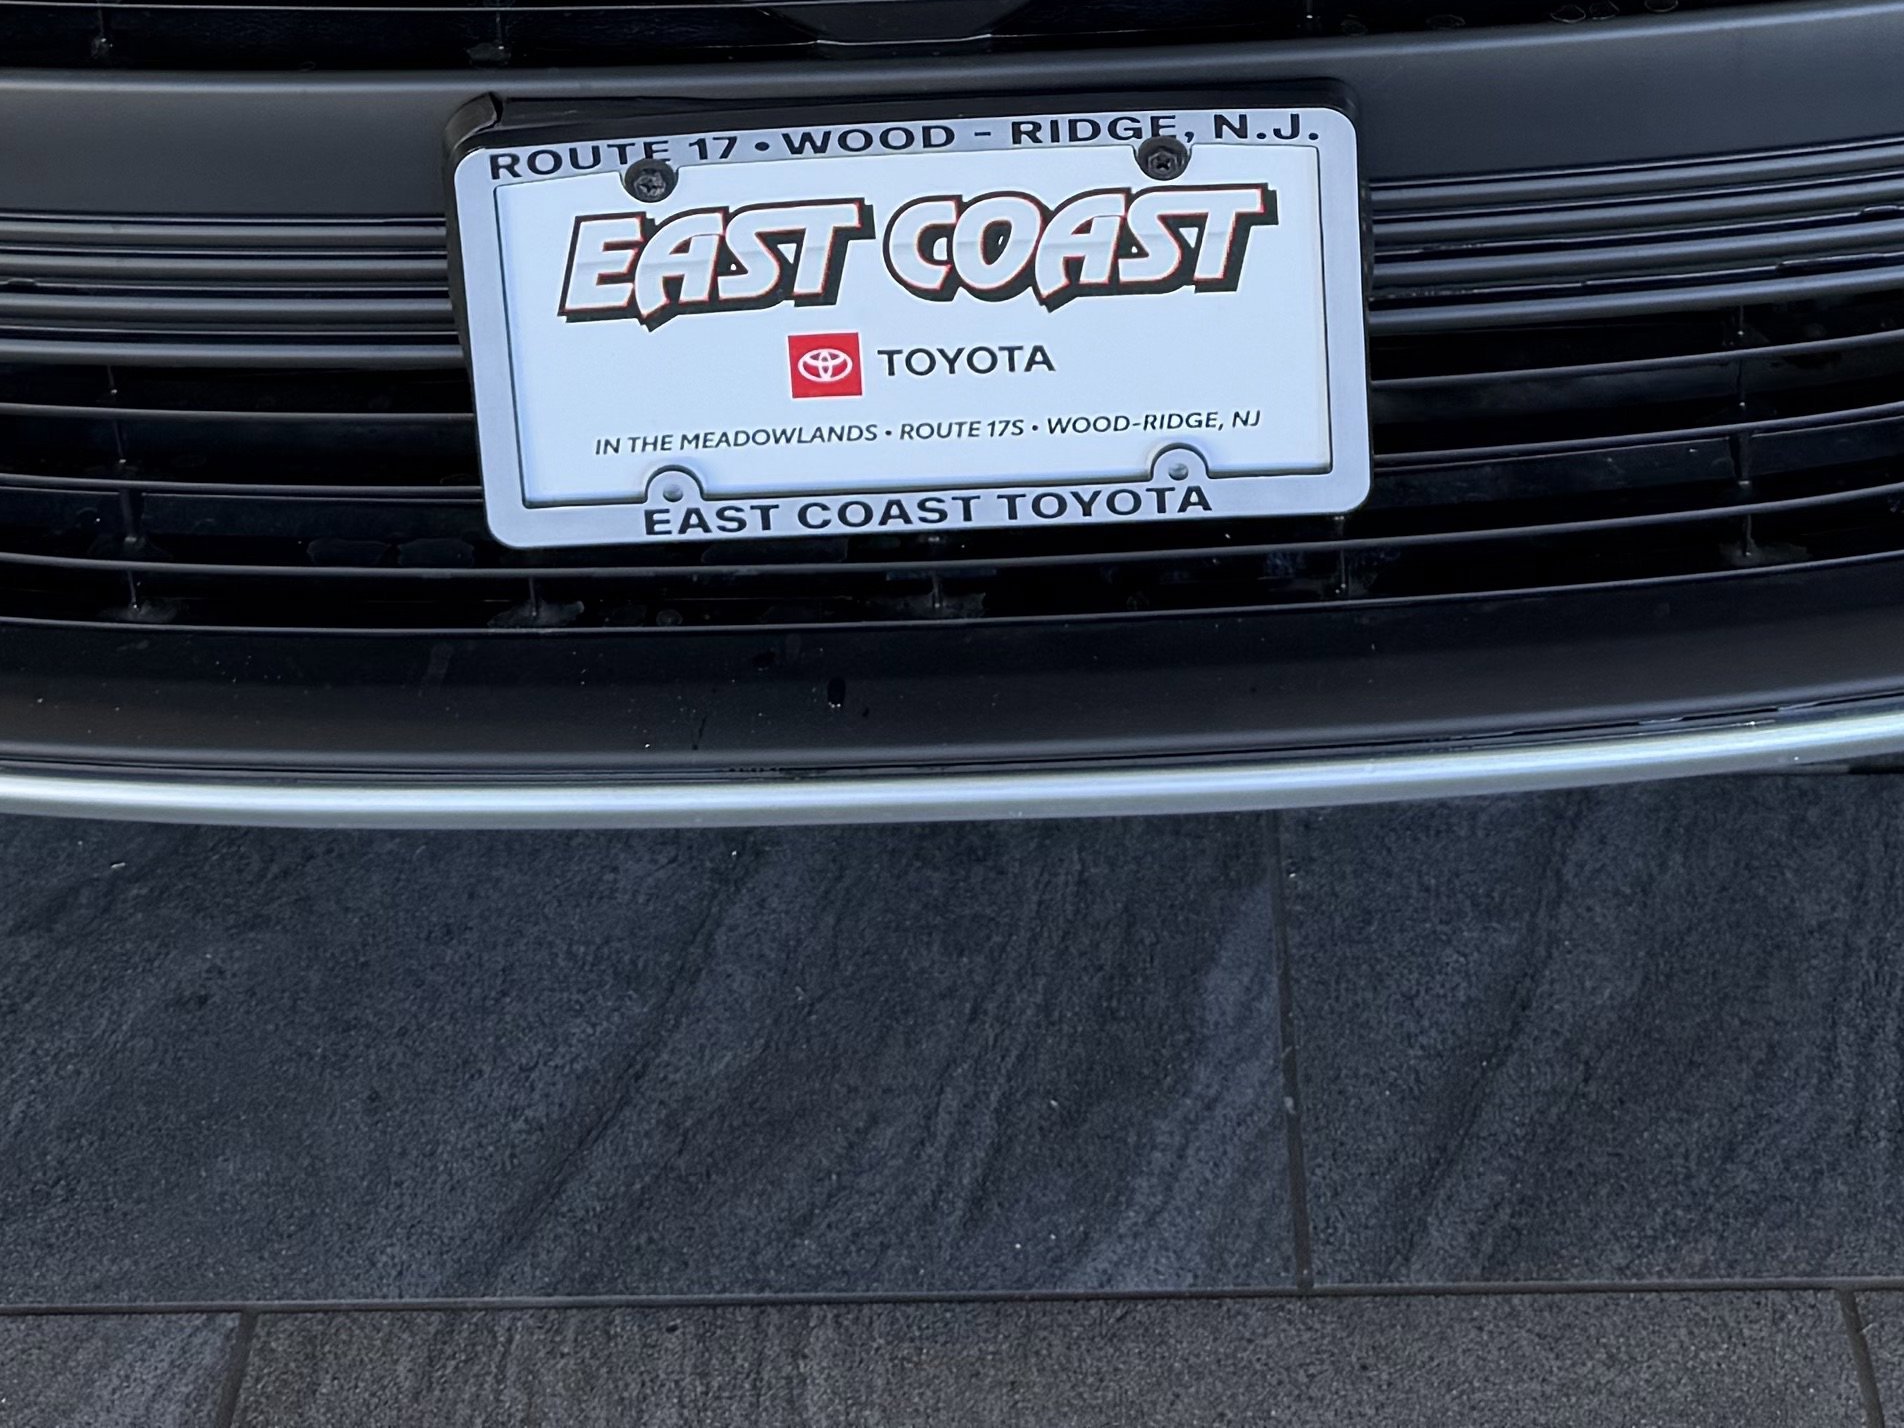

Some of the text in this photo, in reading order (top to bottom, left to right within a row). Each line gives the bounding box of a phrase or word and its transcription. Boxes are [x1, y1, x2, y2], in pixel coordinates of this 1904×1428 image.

[490, 113, 1319, 180] ROUTE 17 WOOD RIDGE, N.J.
[557, 182, 1279, 332] EAST COAST
[877, 345, 1056, 376] TOYOTA
[595, 409, 1261, 455] IN THE MEADOWLANDS ROUTE 17S WOOD-RIDGE, NJ
[644, 485, 1212, 536] EAST COAST TOYOTA
